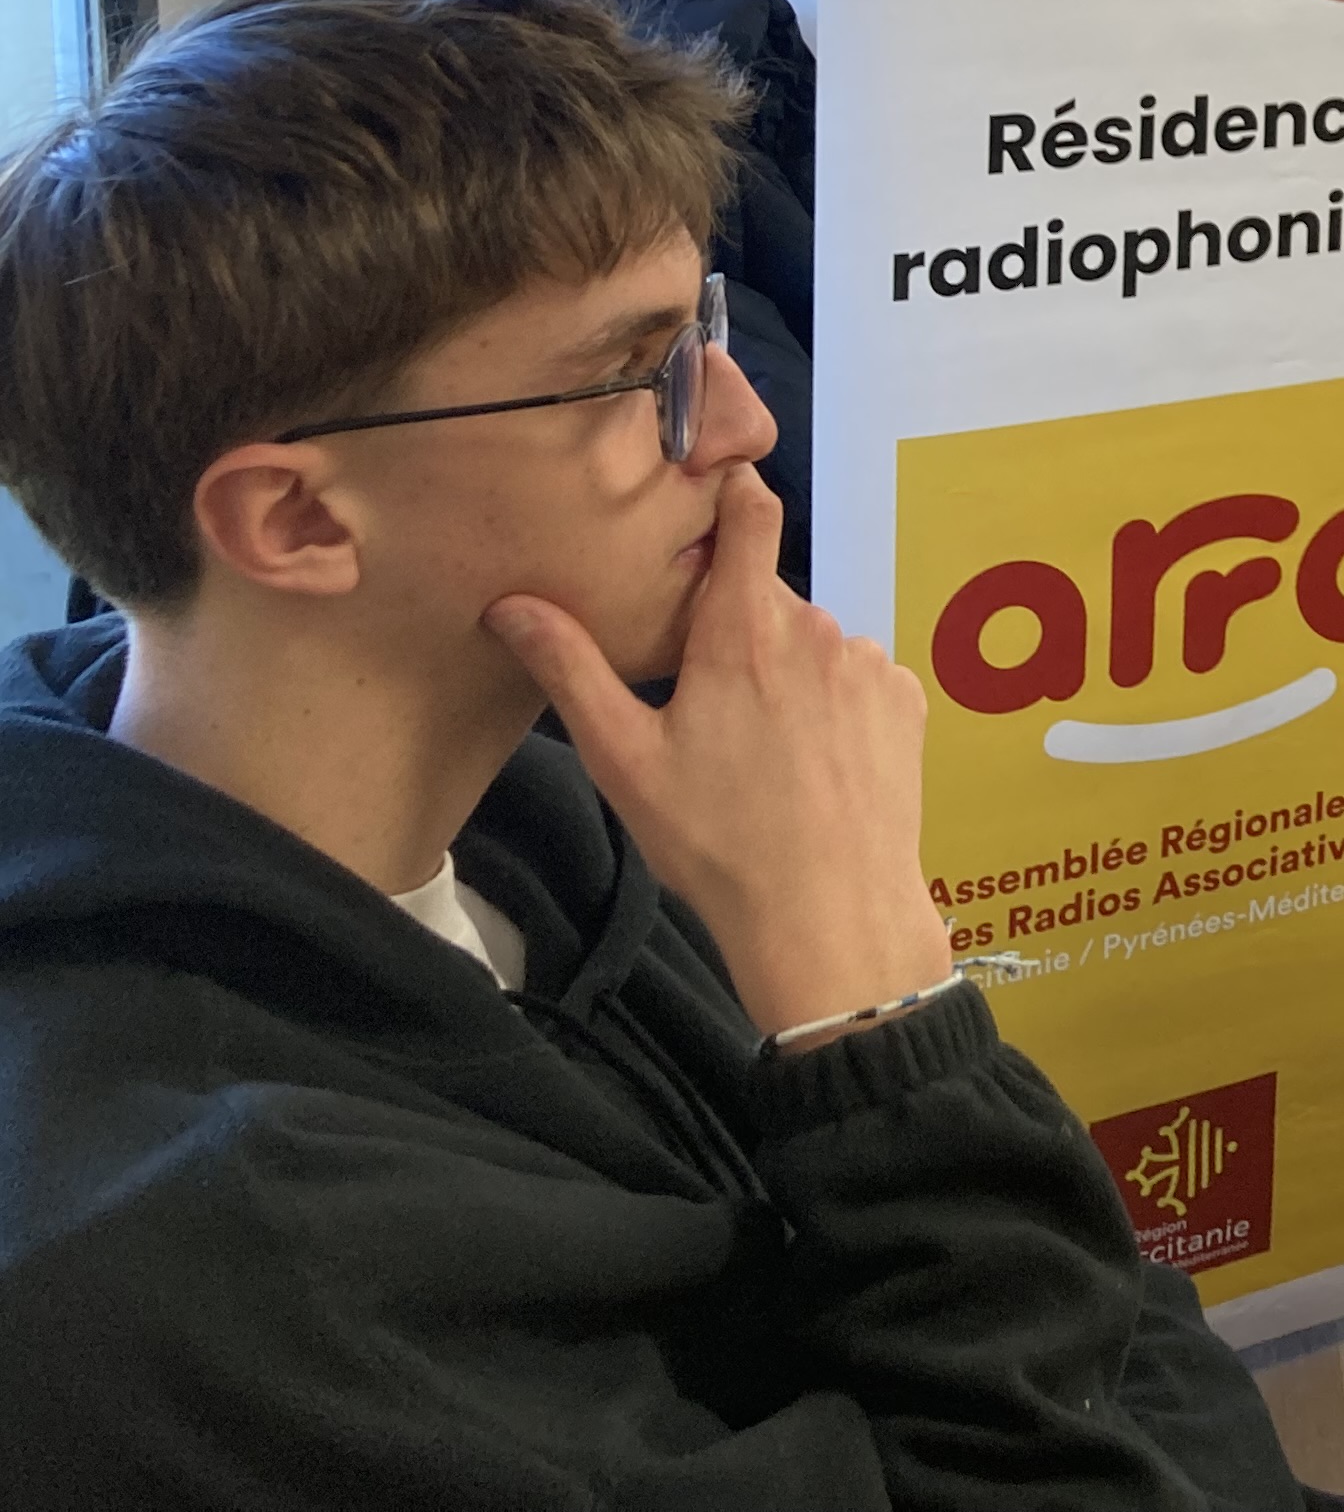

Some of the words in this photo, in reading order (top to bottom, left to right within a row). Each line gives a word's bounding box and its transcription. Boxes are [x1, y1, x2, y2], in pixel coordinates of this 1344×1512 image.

[929, 836, 1148, 909] Assemblée
[950, 922, 995, 952] es
[1007, 888, 1142, 940] Radios
[1140, 1217, 1250, 1264] citanie
